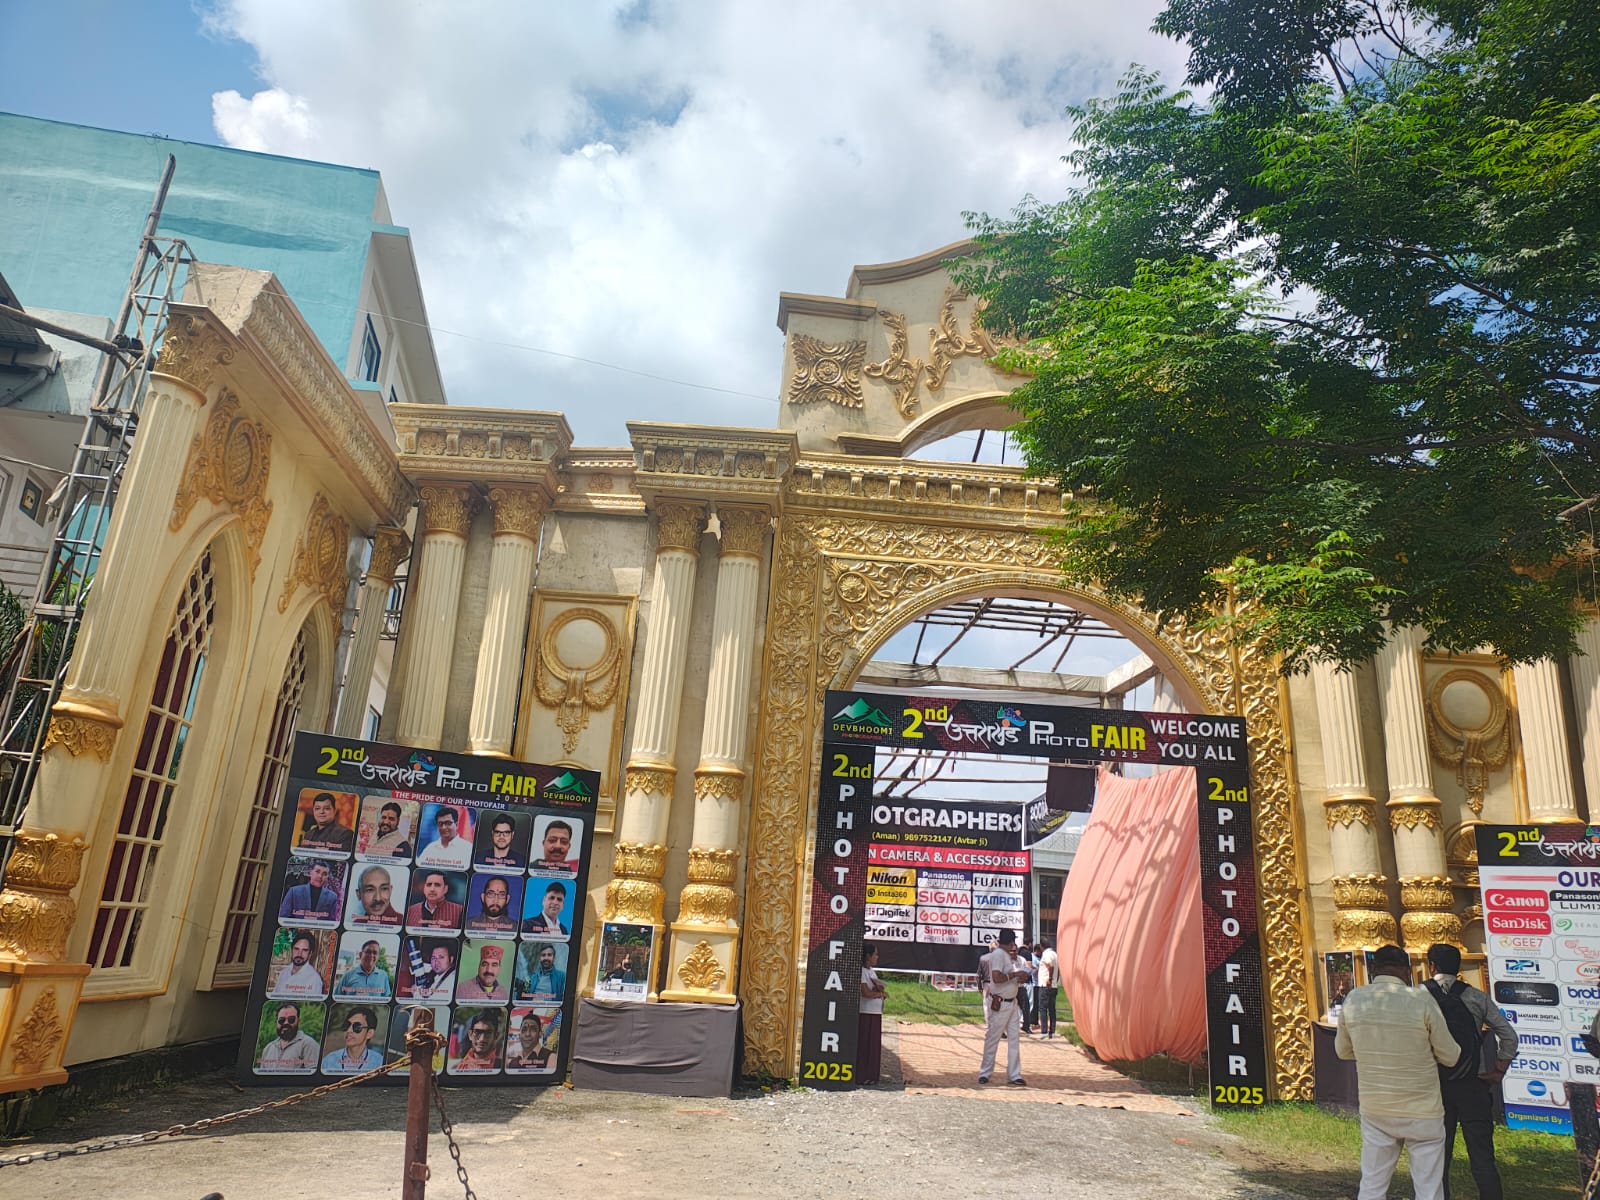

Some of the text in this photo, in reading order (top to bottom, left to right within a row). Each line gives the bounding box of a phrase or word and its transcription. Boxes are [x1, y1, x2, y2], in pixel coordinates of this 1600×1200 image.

[833, 723, 893, 735] DEVBHOOMI
[902, 706, 948, 739] 2nd
[1150, 719, 1240, 739] WELCOME
[1091, 724, 1146, 751] FAIR
[1100, 749, 1138, 759] 2025
[1157, 742, 1236, 761] YOU ALL
[316, 747, 365, 776] 2nd
[832, 753, 872, 779] 2nd
[490, 772, 537, 798] FAIR
[1208, 777, 1248, 802] 2nd
[395, 791, 506, 810] THE PRIDE OF OUR PHOTOFAIR
[495, 794, 528, 804] 2025
[543, 791, 592, 803] DEVBHOOMI
[871, 805, 1022, 833] OTGRAPHERS
[872, 832, 900, 842] (Aman)
[904, 832, 952, 844] 9897522147
[1497, 828, 1540, 857] 2nd
[880, 849, 930, 862] CAMERA
[934, 852, 943, 863] &
[946, 853, 1026, 868] ACCESSORIES
[870, 872, 907, 884] Nikon
[922, 871, 965, 880] Panasonic
[973, 876, 1023, 889] FUJIFILM
[1558, 870, 1600, 888] OUR
[877, 890, 908, 898] Insta360
[918, 890, 970, 905] SIGMA
[974, 894, 1022, 907] TAMRON
[1490, 893, 1545, 907] Canon
[1556, 892, 1600, 900] Panason
[919, 909, 969, 924] Godox
[1492, 917, 1548, 930] SanDisk
[864, 925, 910, 938] Prolite
[924, 926, 959, 937] Simpex
[1512, 937, 1544, 947] GEE7
[803, 1062, 853, 1081] 2025
[1511, 1058, 1560, 1072] EPSON
[1215, 1086, 1264, 1105] 2025
[1508, 1111, 1549, 1123] Organized
